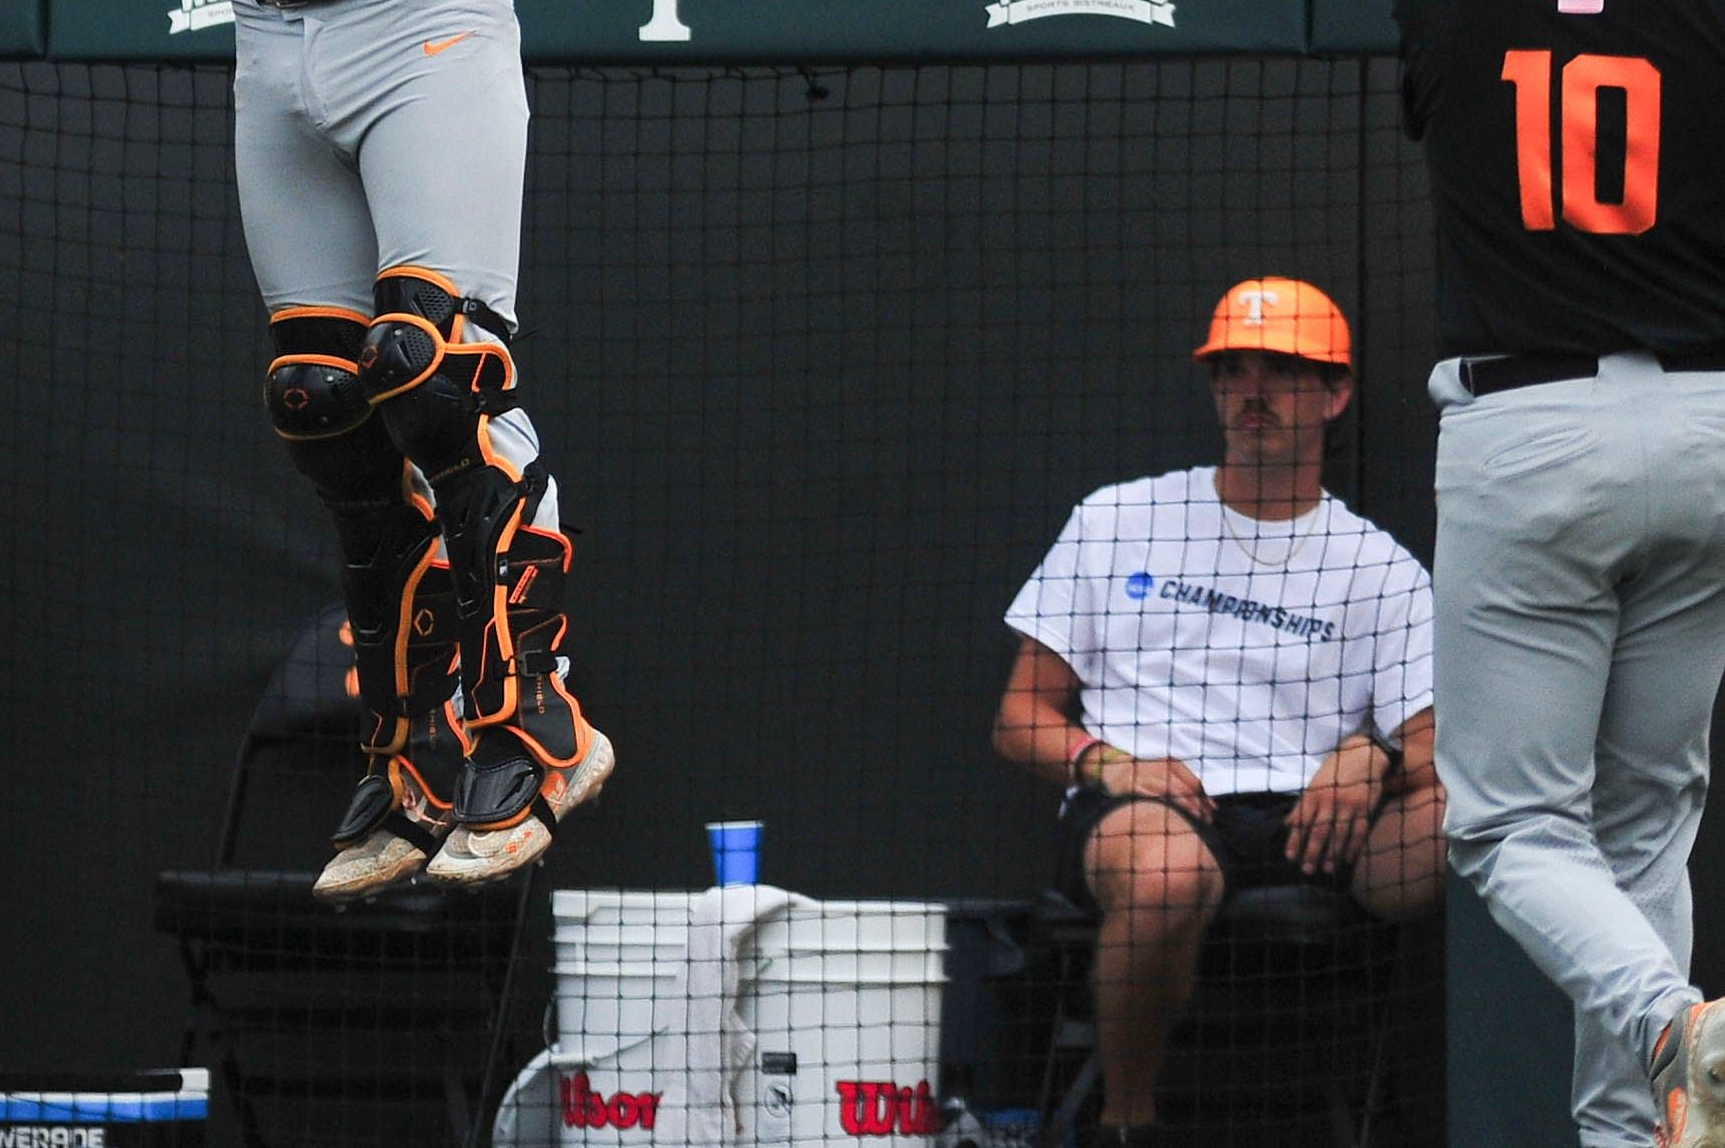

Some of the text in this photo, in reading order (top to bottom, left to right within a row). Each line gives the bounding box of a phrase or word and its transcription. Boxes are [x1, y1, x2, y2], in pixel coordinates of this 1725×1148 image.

[1500, 50, 1661, 235] 10
[1239, 291, 1278, 325] T
[1160, 579, 1336, 643] CHAMPIONSHIPS
